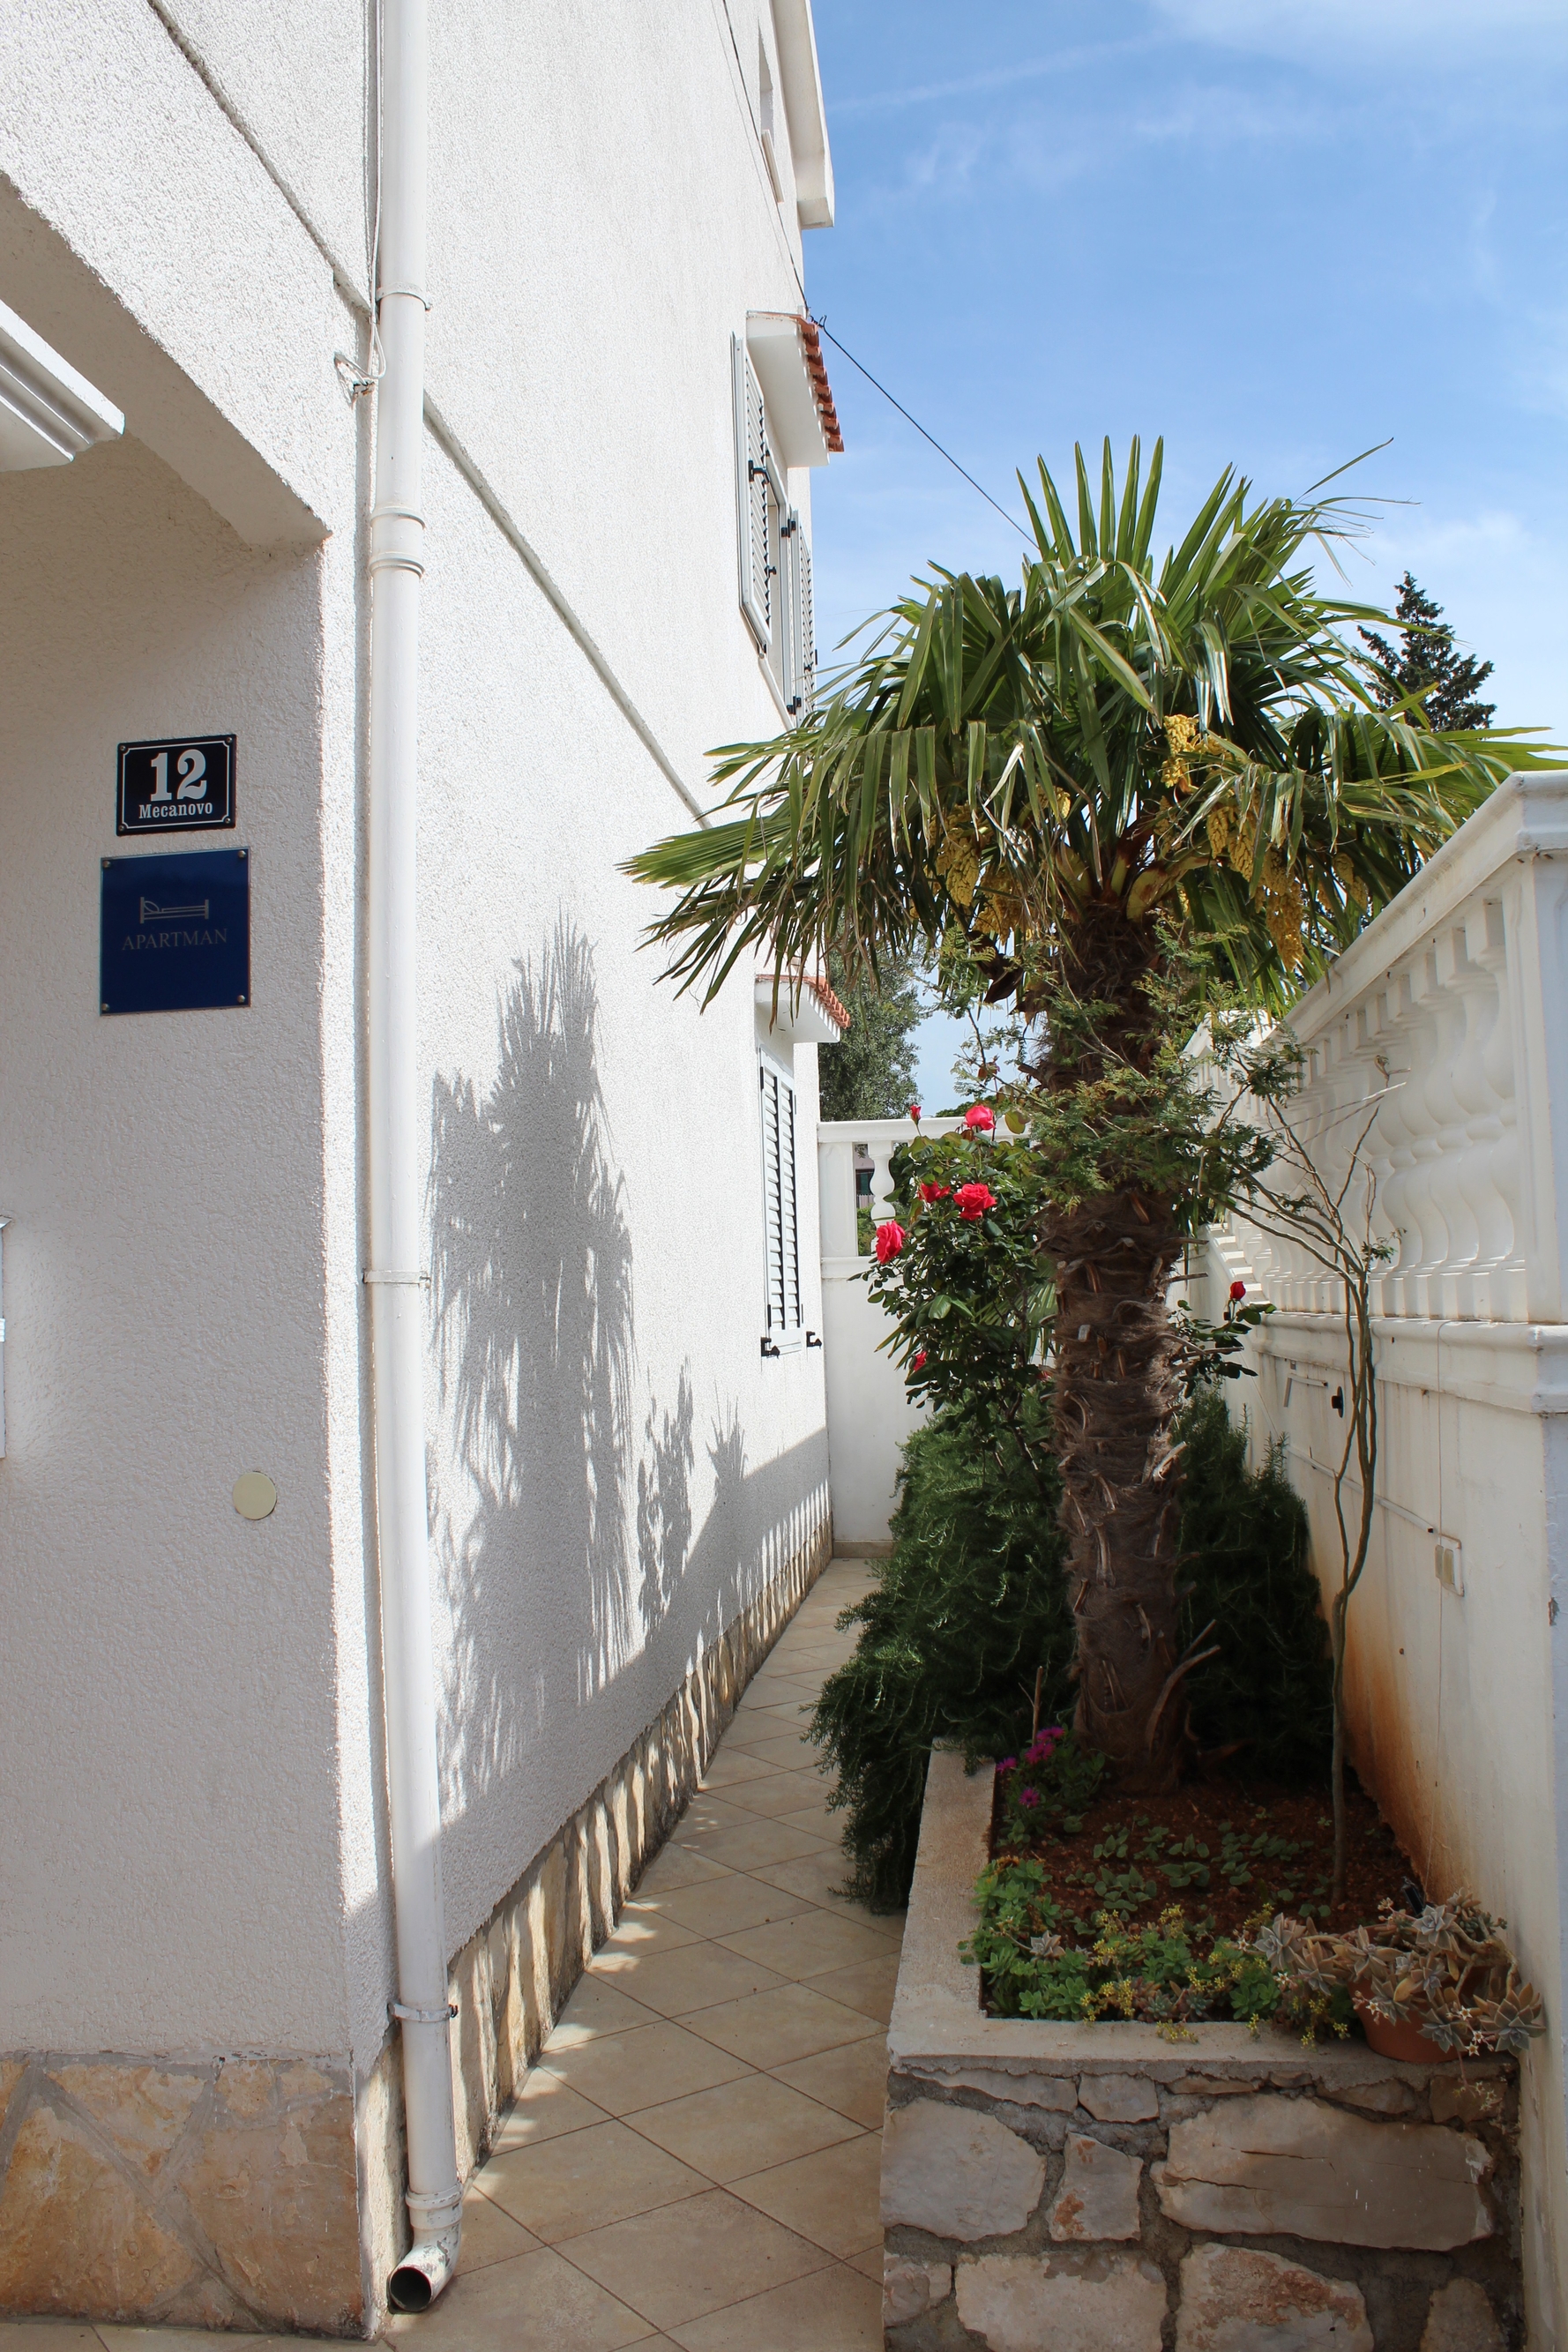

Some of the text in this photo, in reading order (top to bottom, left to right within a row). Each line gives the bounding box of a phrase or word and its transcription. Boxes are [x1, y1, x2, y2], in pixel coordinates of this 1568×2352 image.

[150, 749, 207, 802] 12
[138, 802, 213, 819] Mecanovo
[122, 928, 228, 951] APARTMAN
